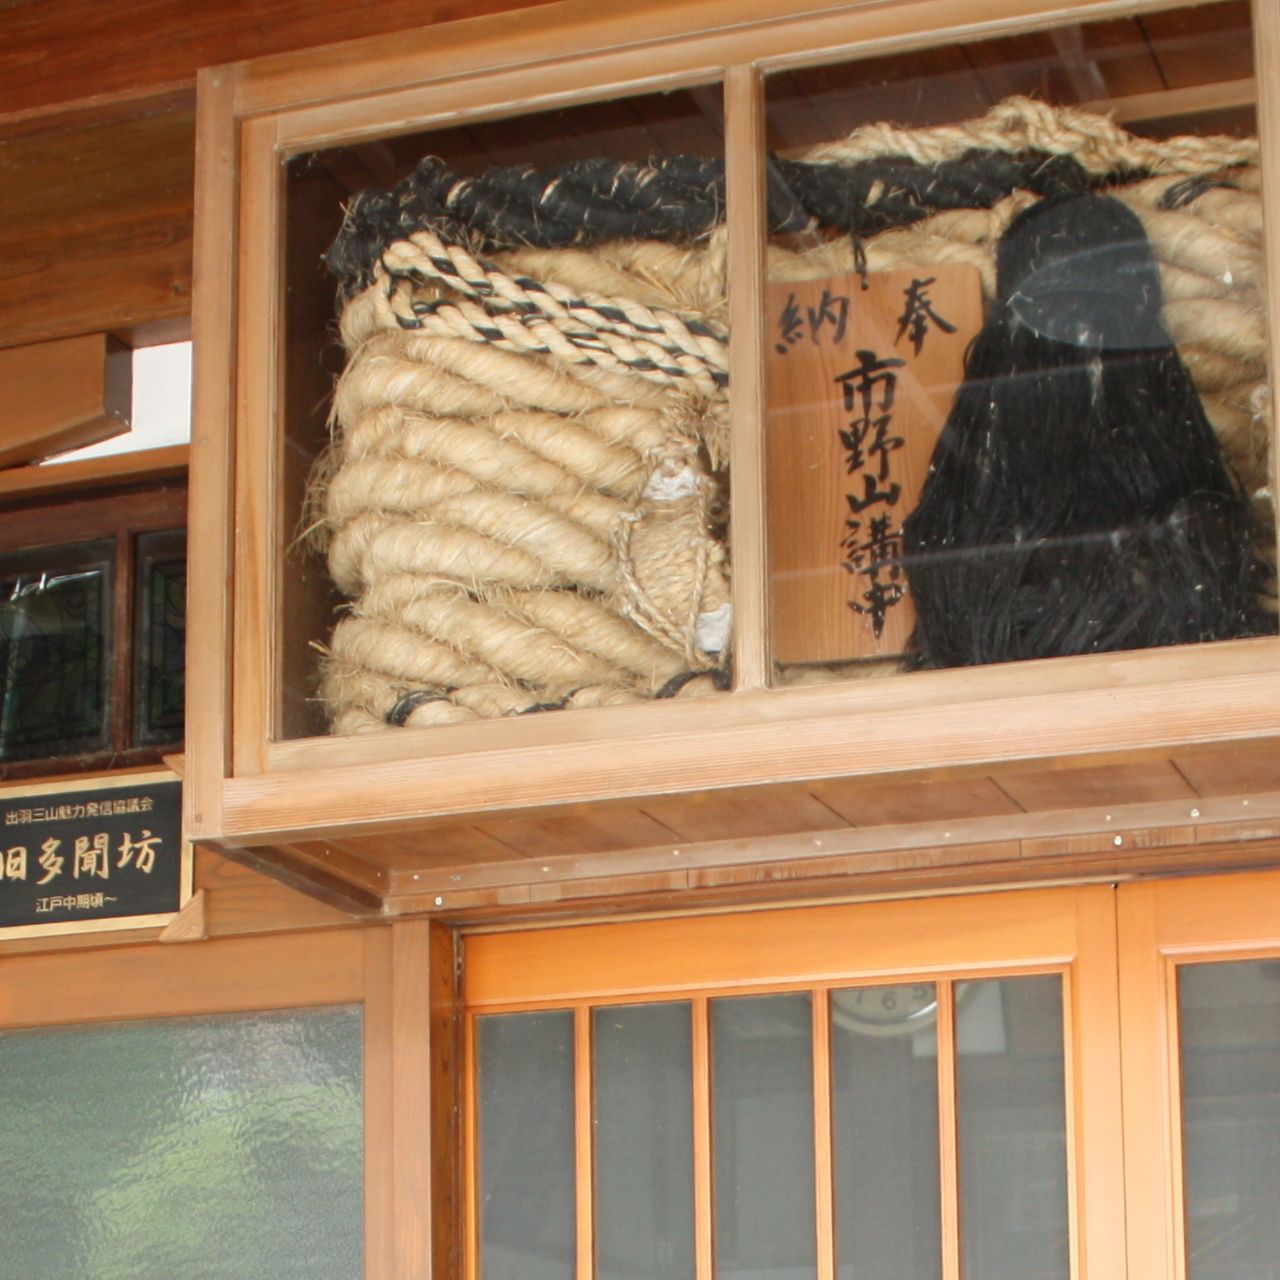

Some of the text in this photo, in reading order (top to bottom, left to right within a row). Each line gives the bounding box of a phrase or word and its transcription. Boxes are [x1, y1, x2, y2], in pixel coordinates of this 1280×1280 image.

[834, 349, 906, 640] 市野山講中
[5, 796, 154, 826] 出羽三山魅力発信協議会
[882, 990, 897, 1010] 6
